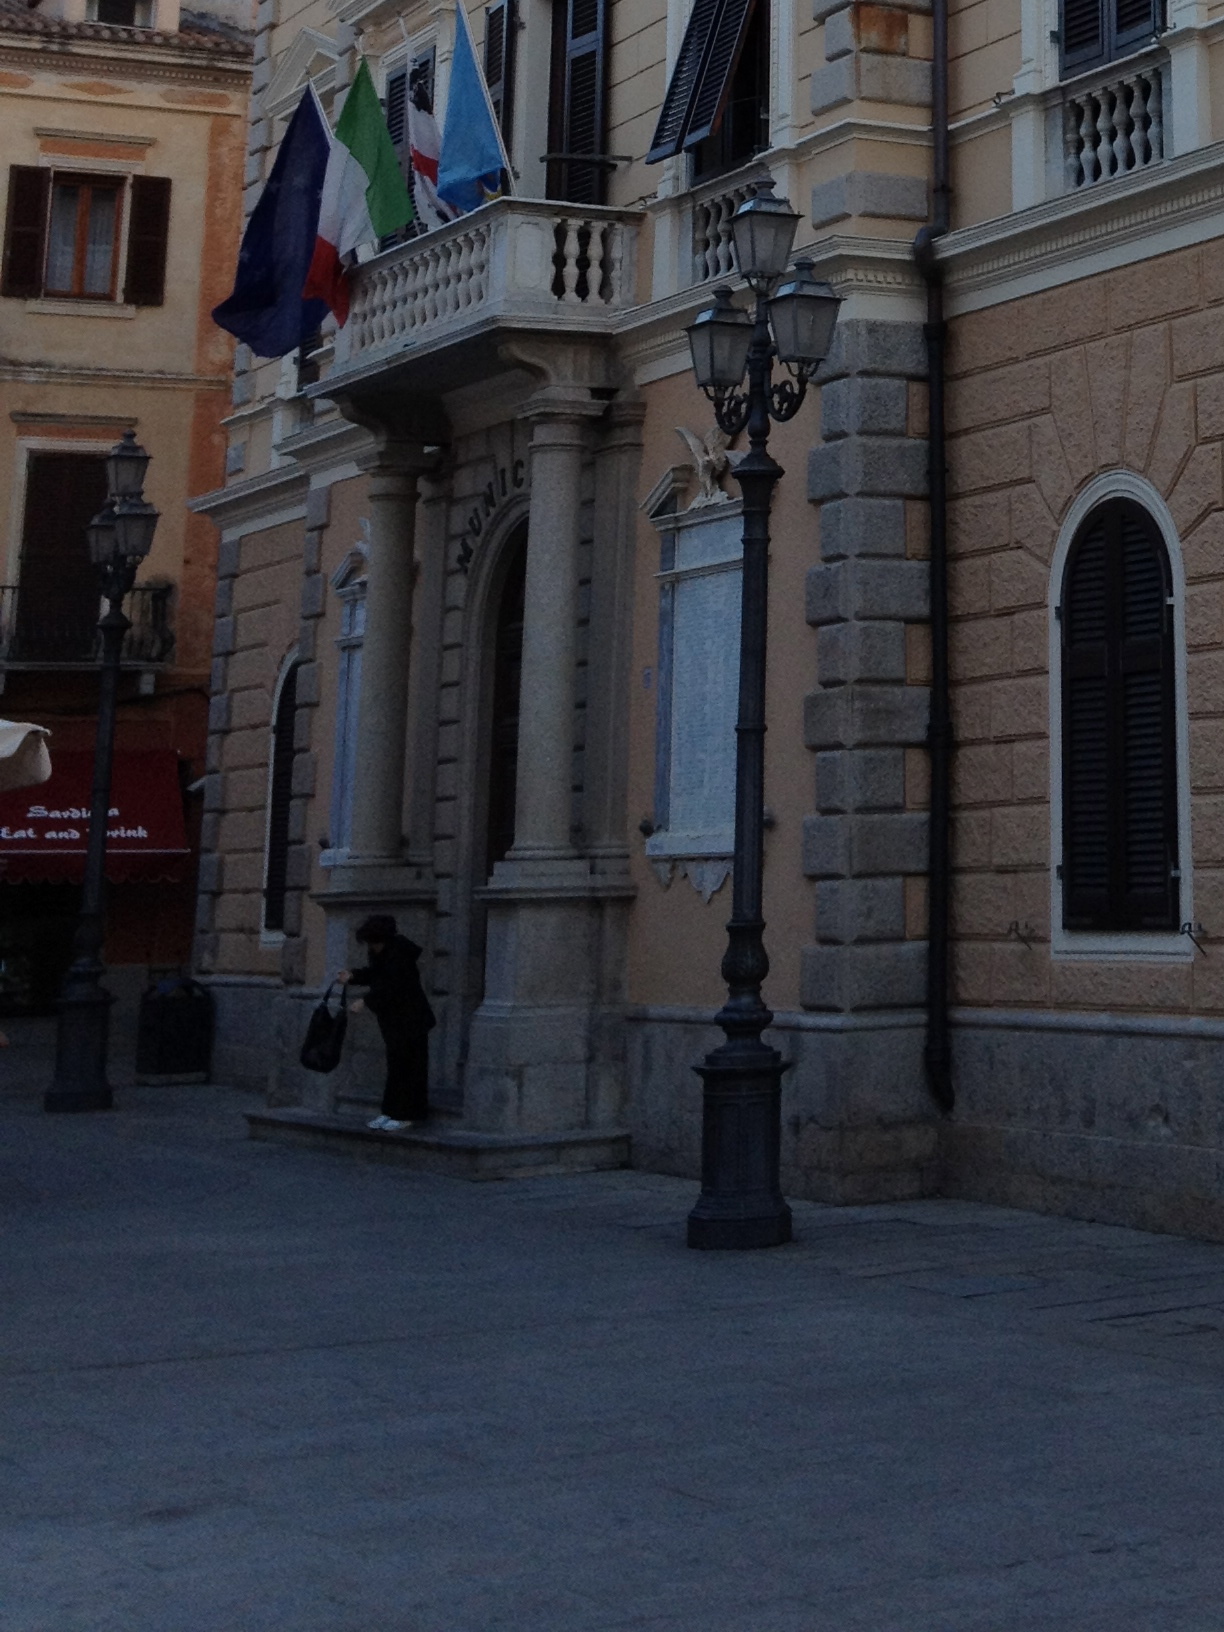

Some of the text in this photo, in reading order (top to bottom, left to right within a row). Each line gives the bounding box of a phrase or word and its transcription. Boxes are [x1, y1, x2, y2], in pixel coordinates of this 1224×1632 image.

[456, 459, 530, 575] MUNIC
[26, 805, 120, 819] Sardia
[44, 828, 81, 840] and
